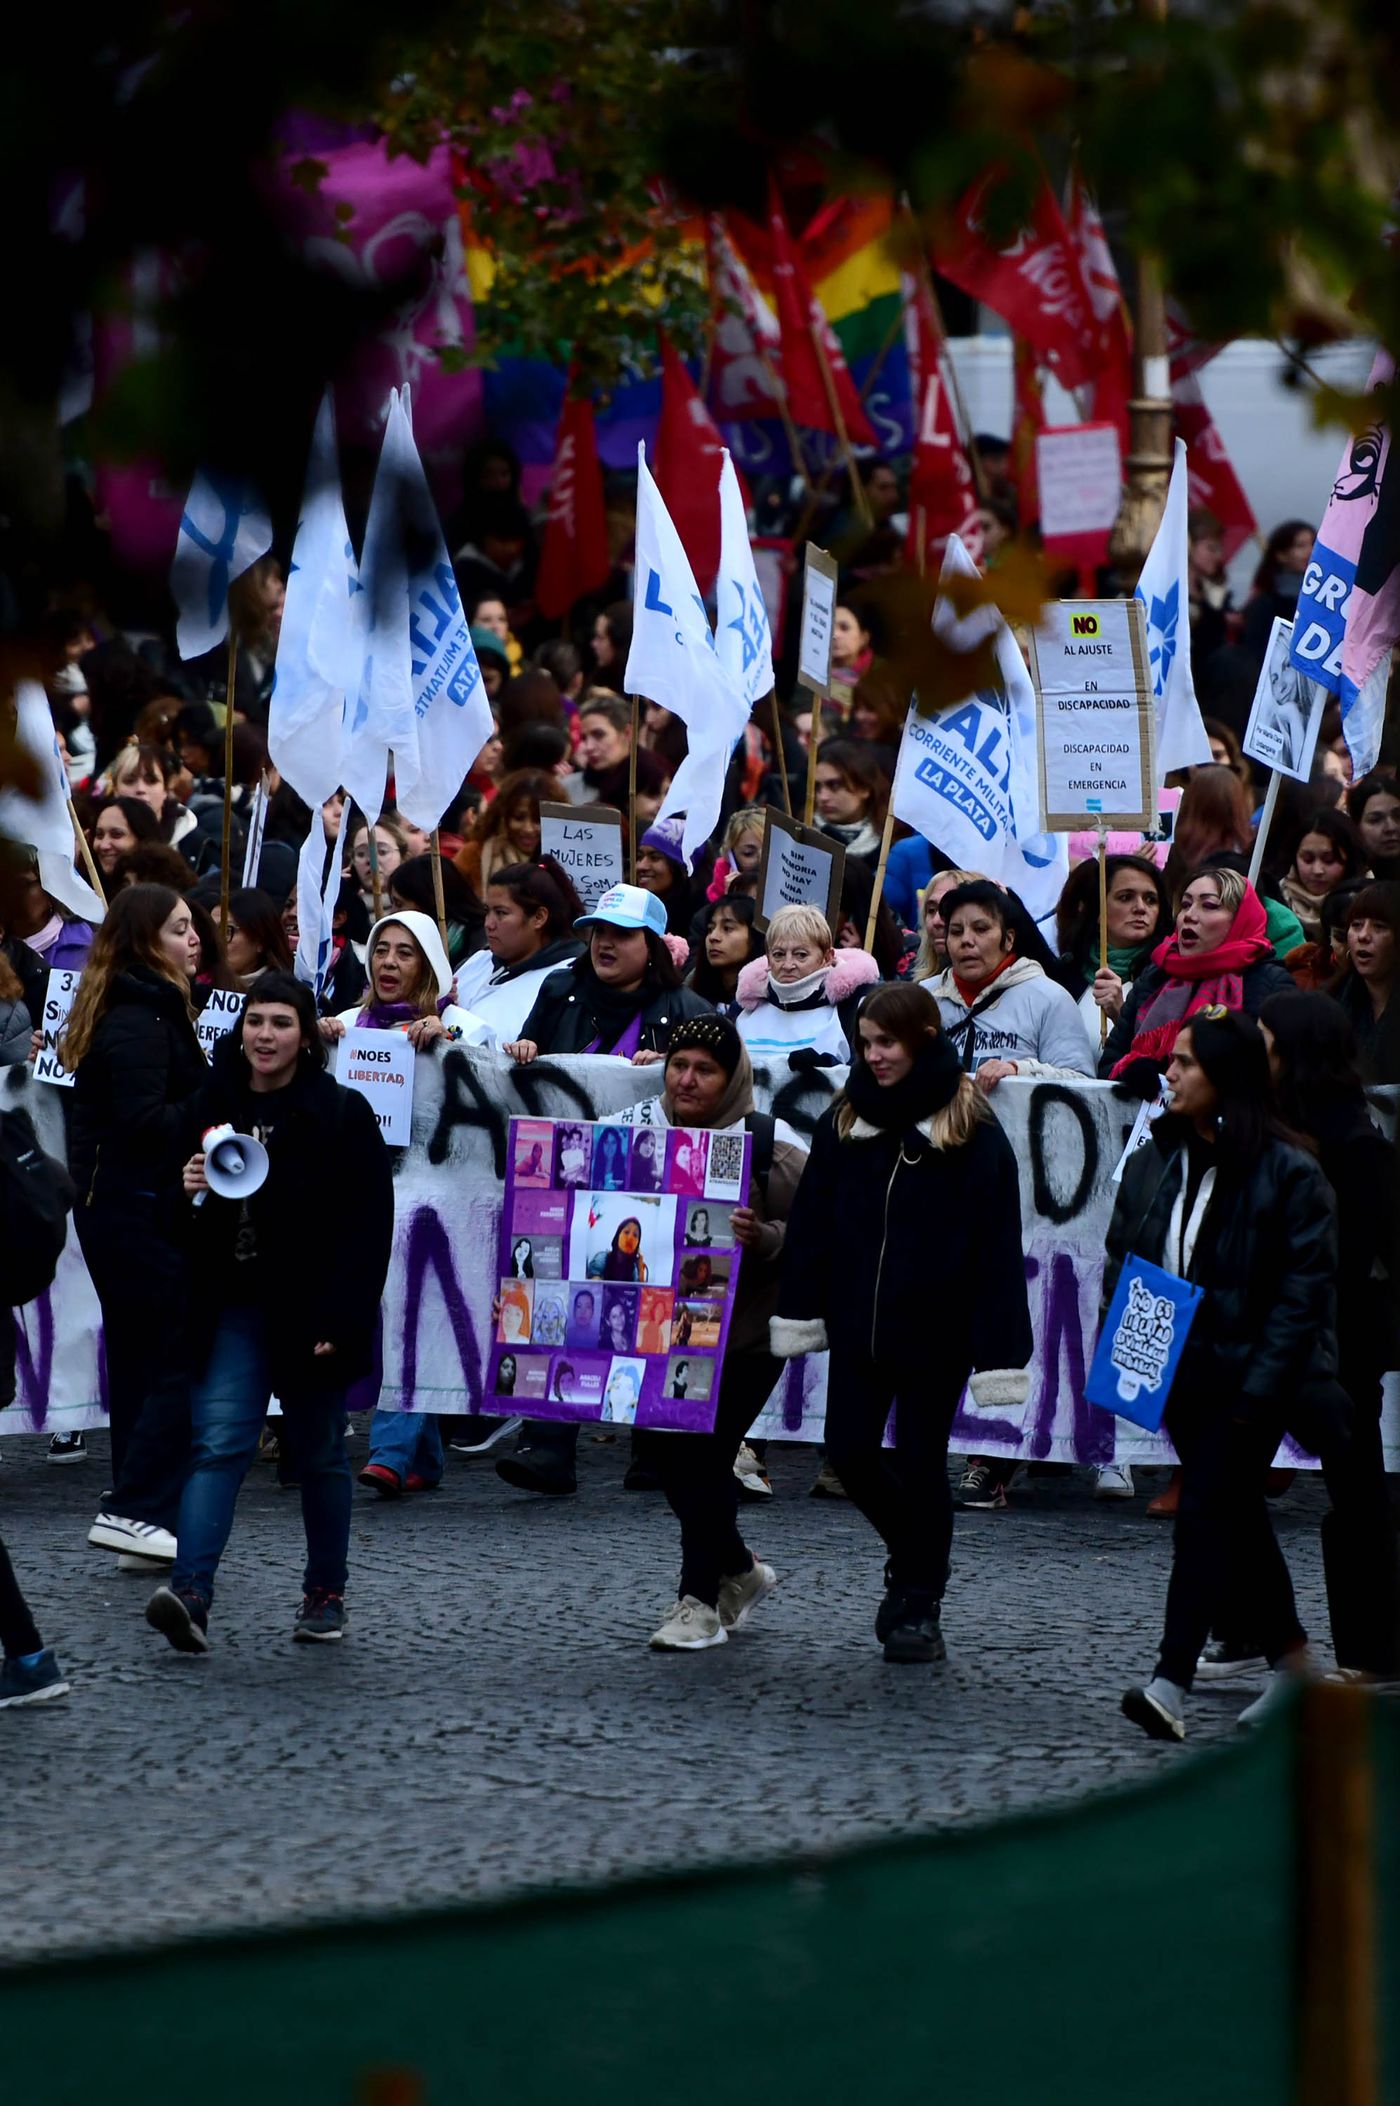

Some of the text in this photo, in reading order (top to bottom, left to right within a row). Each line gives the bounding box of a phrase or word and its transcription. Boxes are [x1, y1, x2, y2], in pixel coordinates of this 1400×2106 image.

[1073, 616, 1098, 635] NO
[1064, 644, 1113, 656] AL AJUSTE
[1084, 680, 1098, 692] EN
[1058, 699, 1130, 711] DISCAPACIDAD
[909, 722, 977, 781] CORRIENTE
[1063, 743, 1130, 754] DISCAPACIDAD
[1090, 762, 1102, 772] EN
[1068, 779, 1127, 790] EMERGENCIA
[920, 763, 993, 834] LA PLATA
[975, 777, 1008, 833] MILITA
[563, 825, 593, 841] LAS
[550, 848, 614, 867] MUJERES
[790, 850, 805, 861] SIN
[781, 853, 818, 877] MEMORIA
[792, 874, 812, 886] HAY
[784, 881, 803, 895] UNA
[60, 972, 74, 992] 3
[350, 1049, 392, 1063] #NOES
